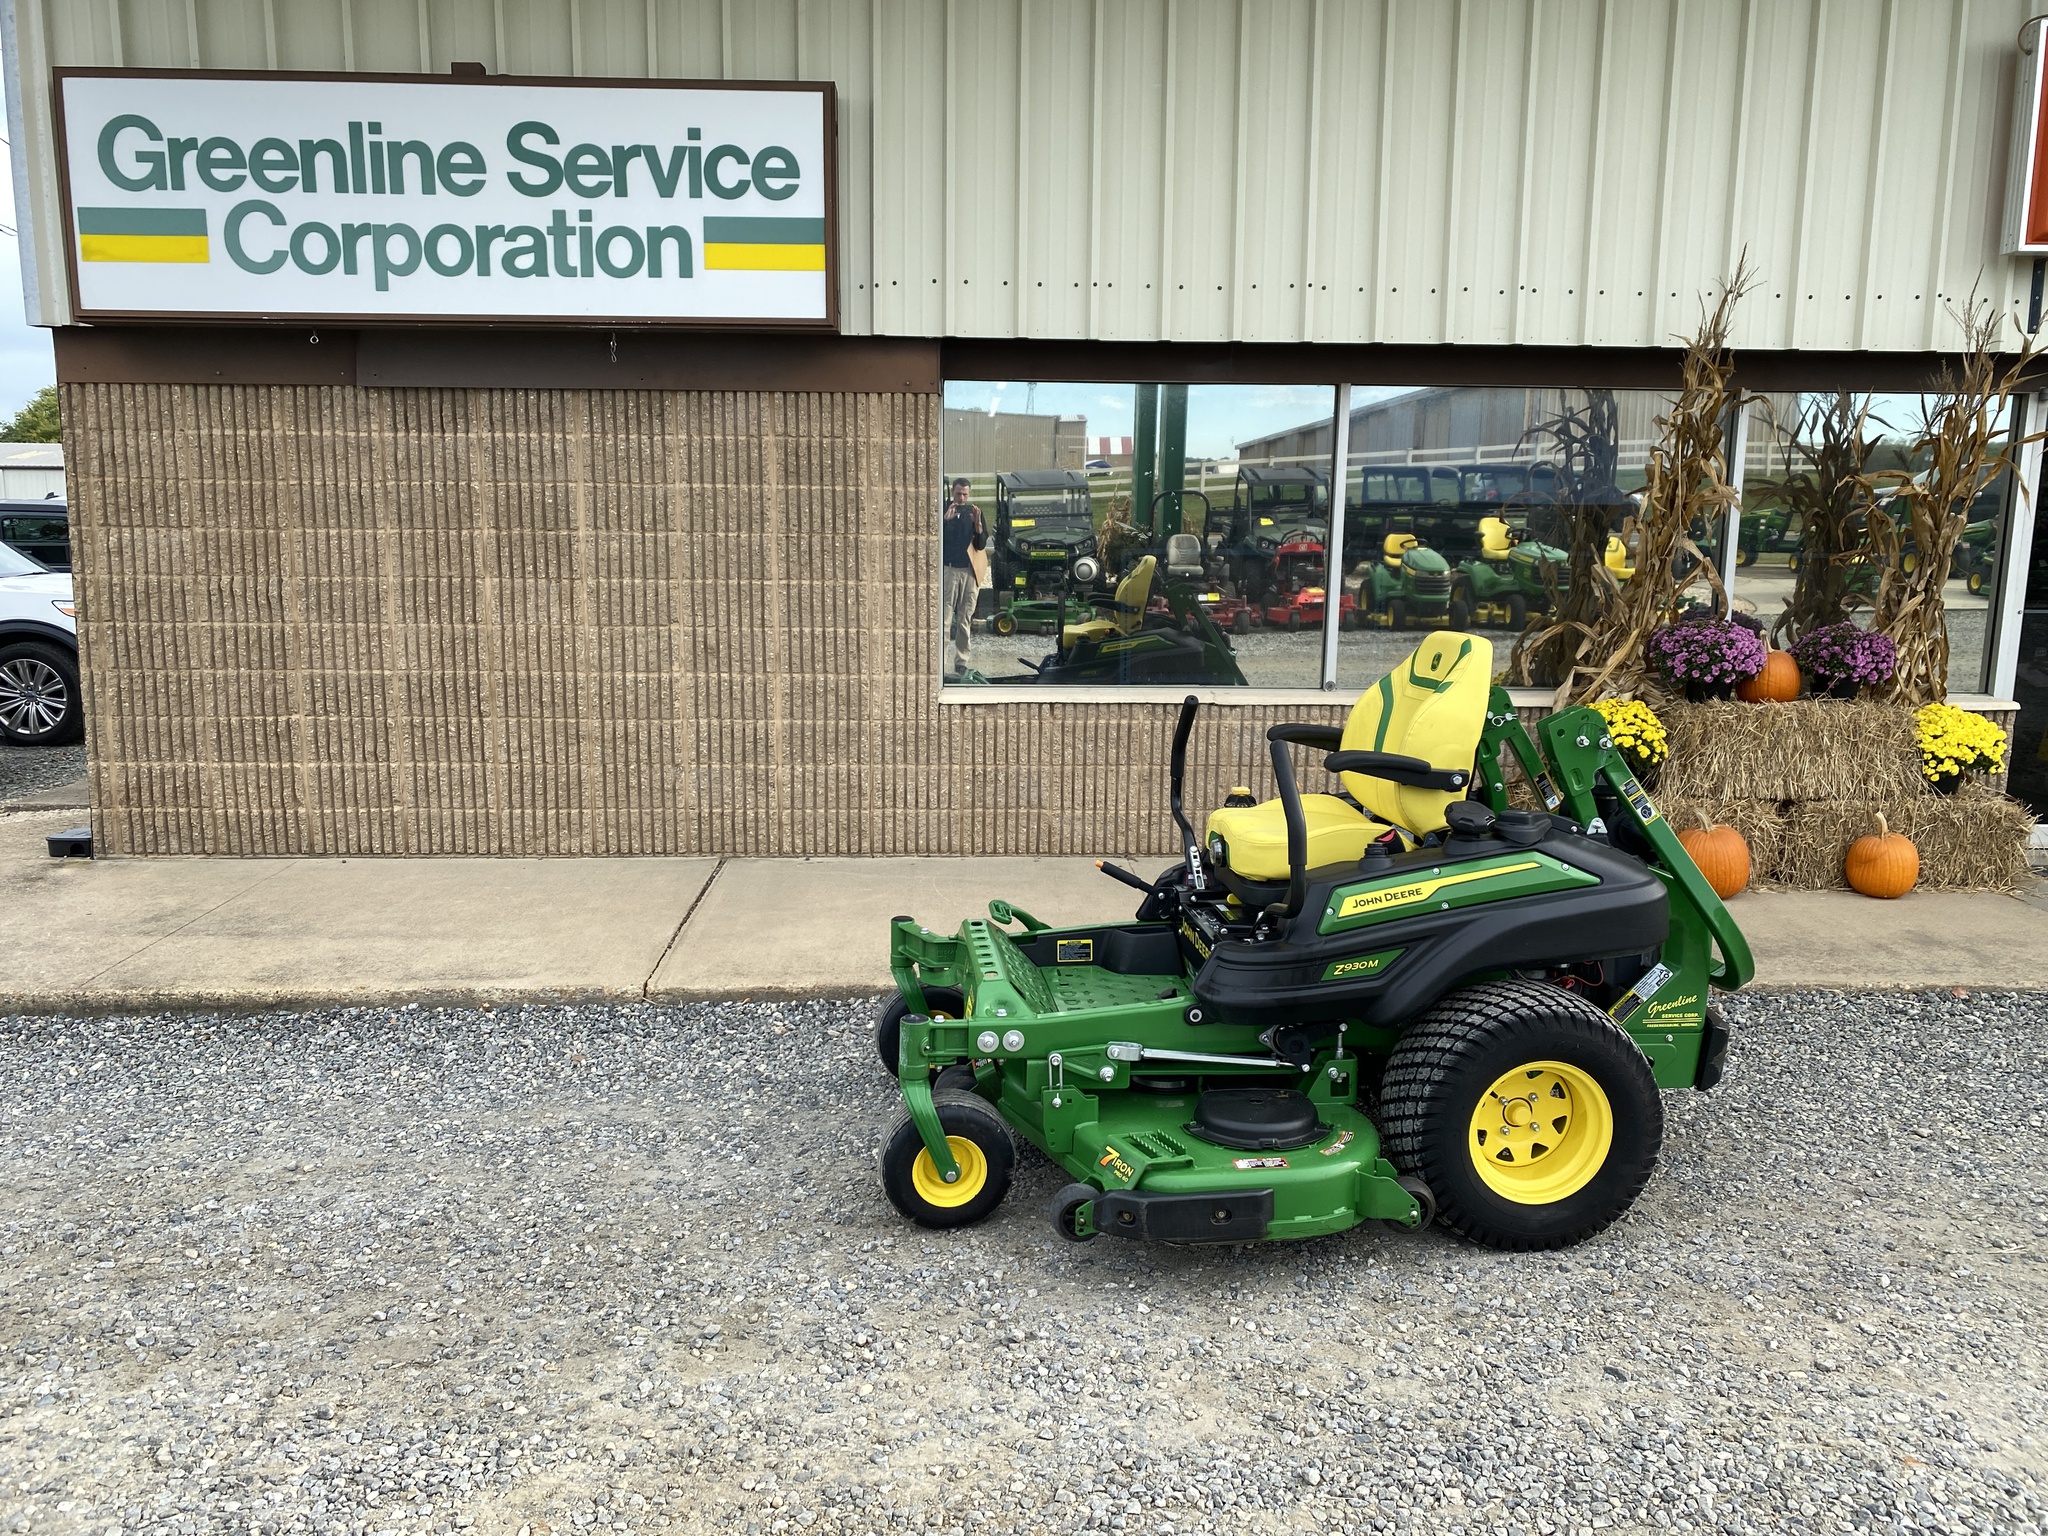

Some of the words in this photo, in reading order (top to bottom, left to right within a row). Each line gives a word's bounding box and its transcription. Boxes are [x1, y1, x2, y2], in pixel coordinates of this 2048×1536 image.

[97, 114, 487, 198] Greenline
[507, 121, 801, 202] Service
[224, 199, 694, 292] Corporation
[1352, 896, 1383, 909] JOHN
[1384, 887, 1423, 902] DEERE
[1333, 959, 1379, 976] Z930M
[1647, 994, 1698, 1018] Greenline
